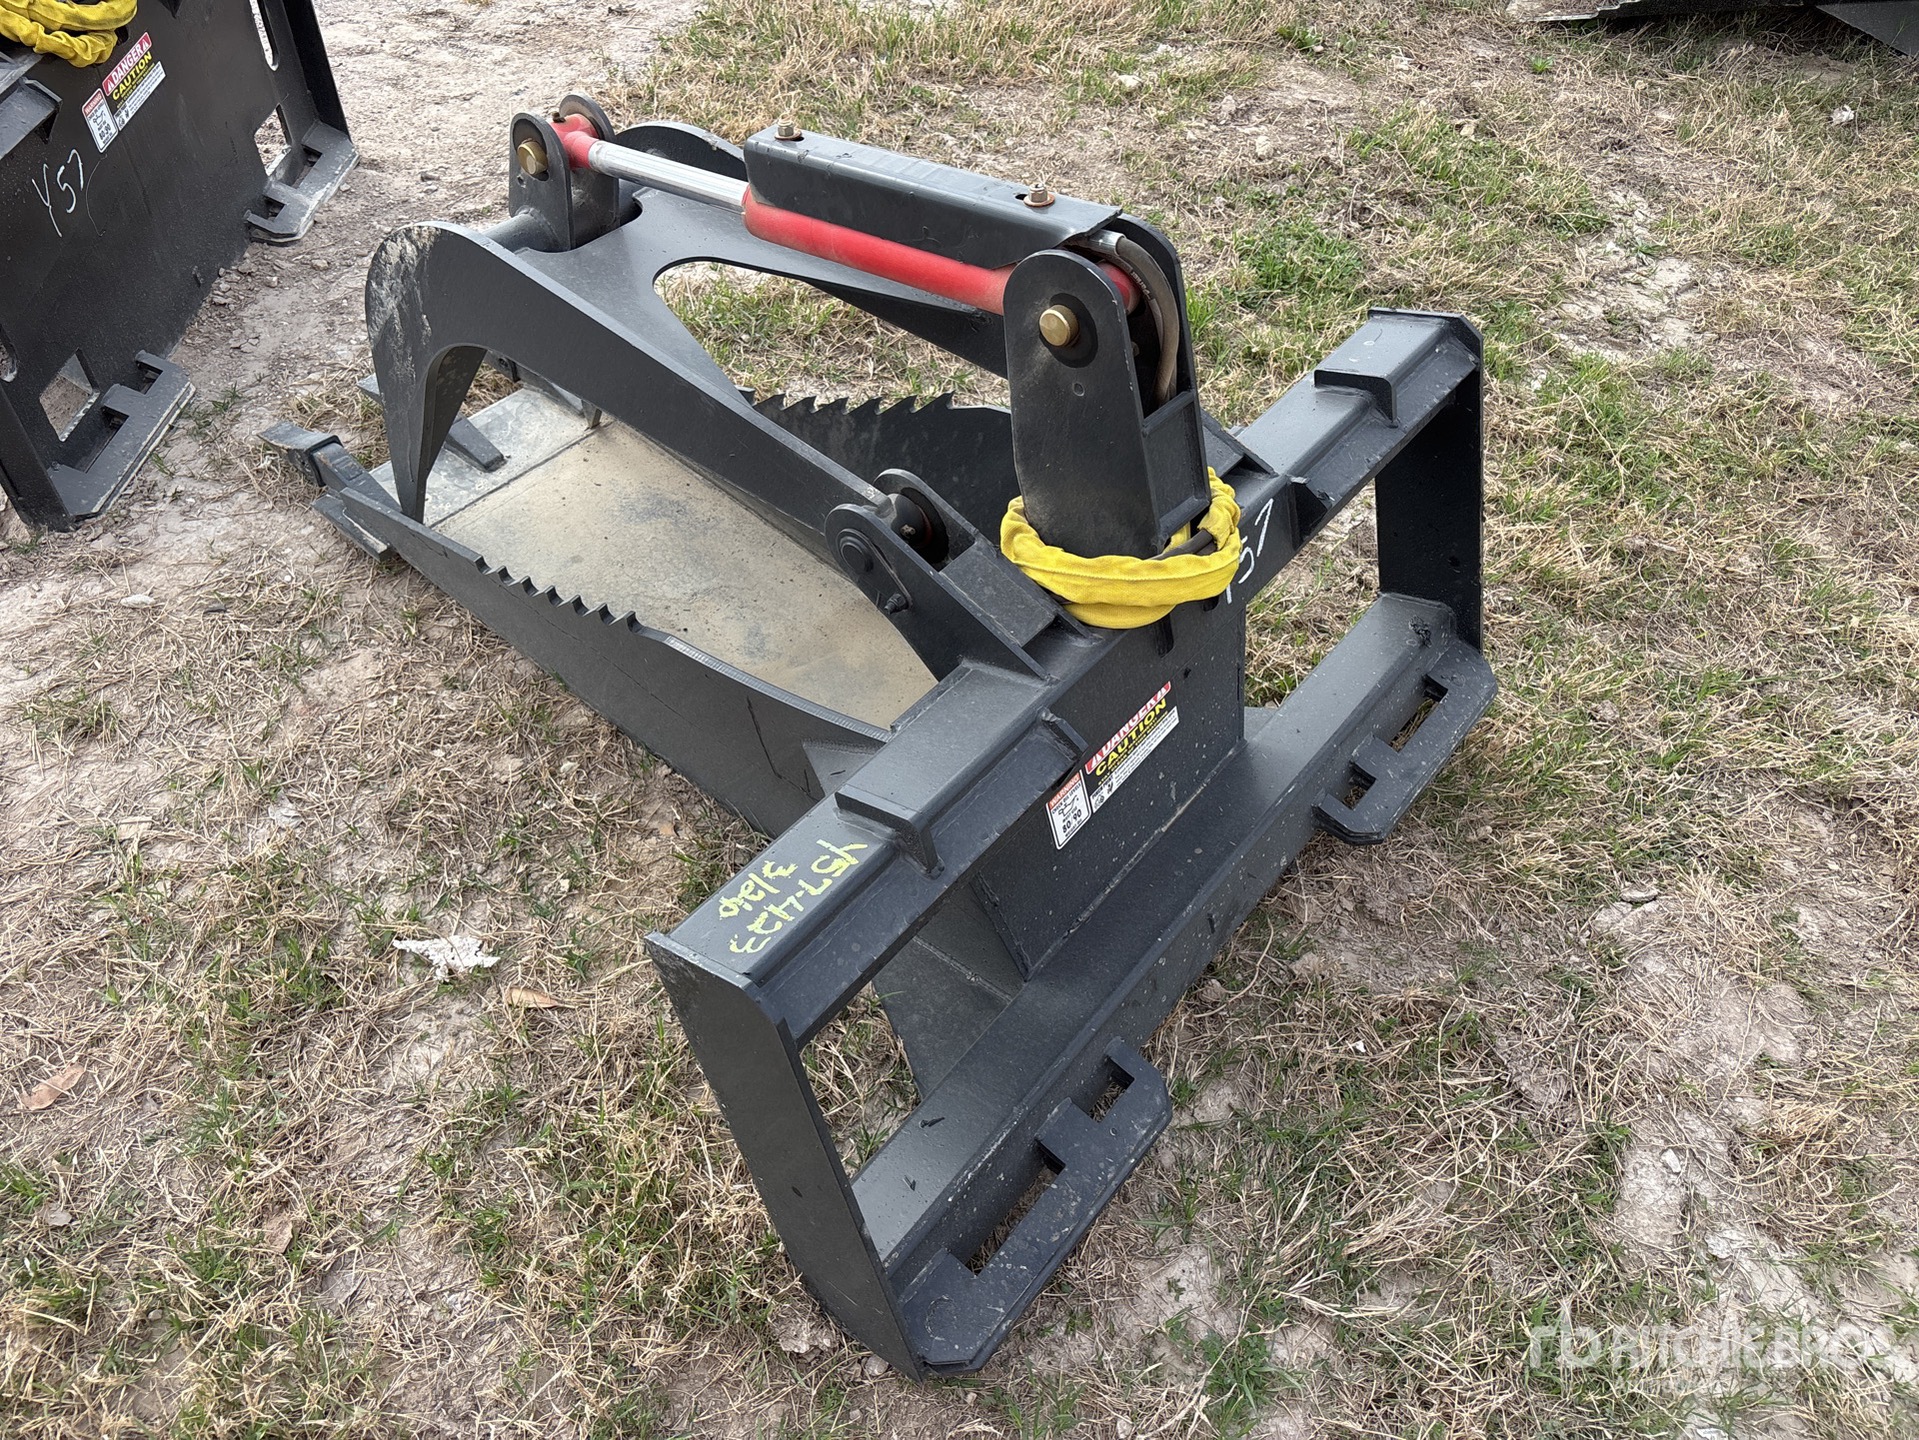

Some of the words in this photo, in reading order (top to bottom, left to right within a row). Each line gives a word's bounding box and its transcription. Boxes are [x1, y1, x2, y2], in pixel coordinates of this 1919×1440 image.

[111, 43, 143, 83] DANGER
[112, 51, 152, 100] CAUTION
[1225, 497, 1274, 605] 57
[1096, 698, 1166, 776] CAUTION
[1102, 697, 1156, 753] DANGER
[1050, 774, 1079, 807] WARNING
